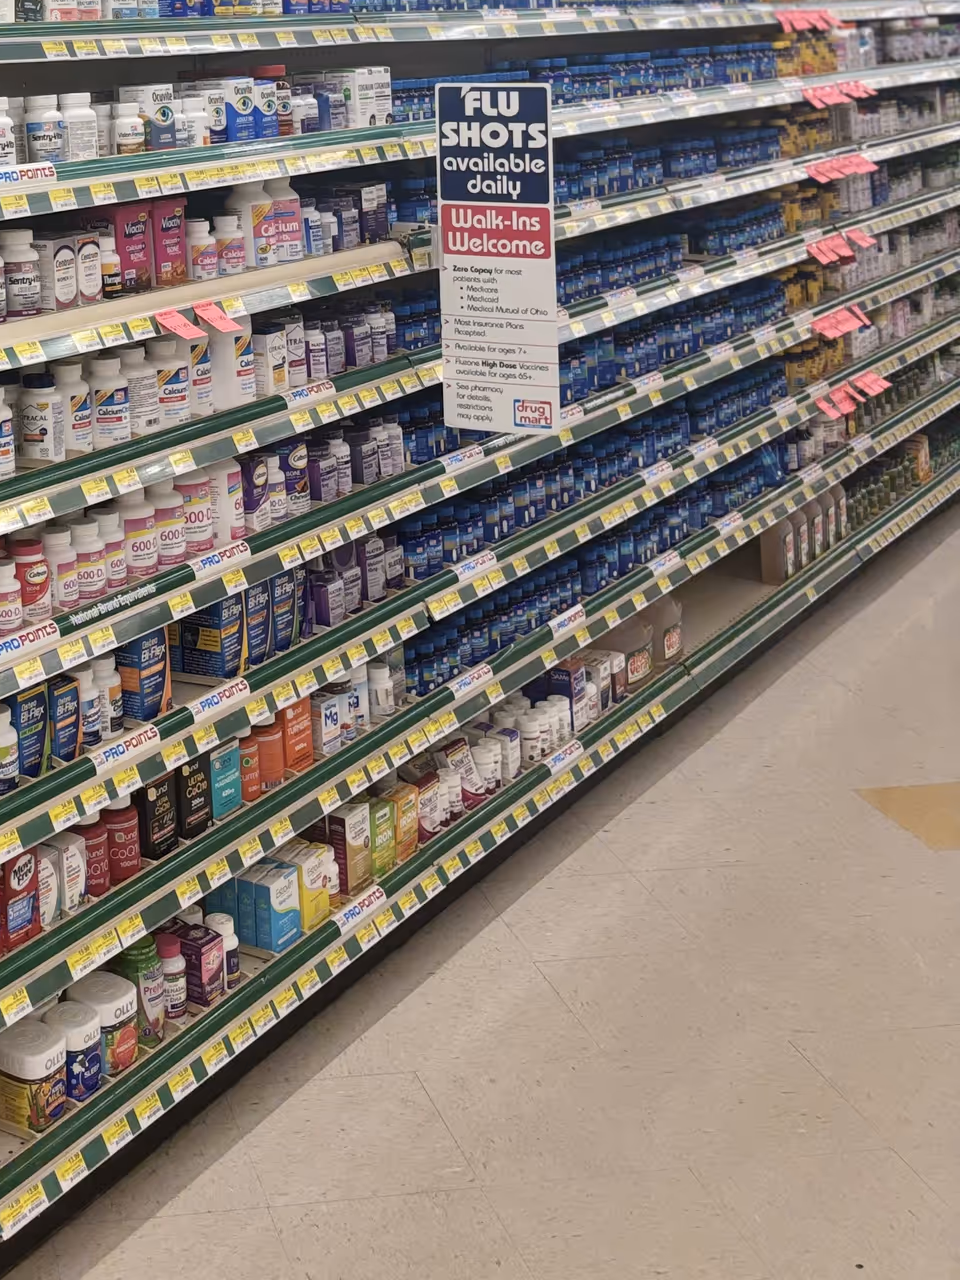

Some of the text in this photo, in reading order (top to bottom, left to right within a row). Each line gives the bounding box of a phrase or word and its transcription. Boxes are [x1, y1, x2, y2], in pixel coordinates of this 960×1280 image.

[152, 91, 173, 102] Ocuvite
[461, 87, 519, 117] FLU
[442, 122, 547, 148] SHOTS
[443, 156, 546, 174] available
[467, 175, 521, 200] daily
[451, 208, 540, 232] Walk-Ins
[448, 231, 545, 256] Welcome
[453, 265, 468, 273] Zero
[470, 266, 493, 275] Copay
[453, 275, 497, 284] patients with
[466, 285, 498, 294] Medicare
[466, 295, 499, 303] Medicaid
[467, 304, 549, 316] Medical Mutual of Ohio
[454, 318, 524, 330] Most Insurance Plans
[455, 342, 486, 352] Available
[487, 344, 497, 353] for
[498, 346, 516, 356] ages
[455, 357, 480, 366] Fluzone
[481, 361, 498, 370] High
[519, 363, 549, 372] Vaccines
[456, 368, 487, 377] available
[488, 370, 498, 378] for
[499, 372, 517, 380] ages
[456, 382, 503, 395] See pharmacy
[456, 392, 466, 400] for
[456, 403, 493, 412] restrictions
[517, 401, 545, 417] drug
[456, 413, 472, 423] may
[520, 415, 552, 425] mart
[324, 712, 339, 727] Mg
[375, 830, 393, 845] IRON
[114, 999, 135, 1019] OLLY
